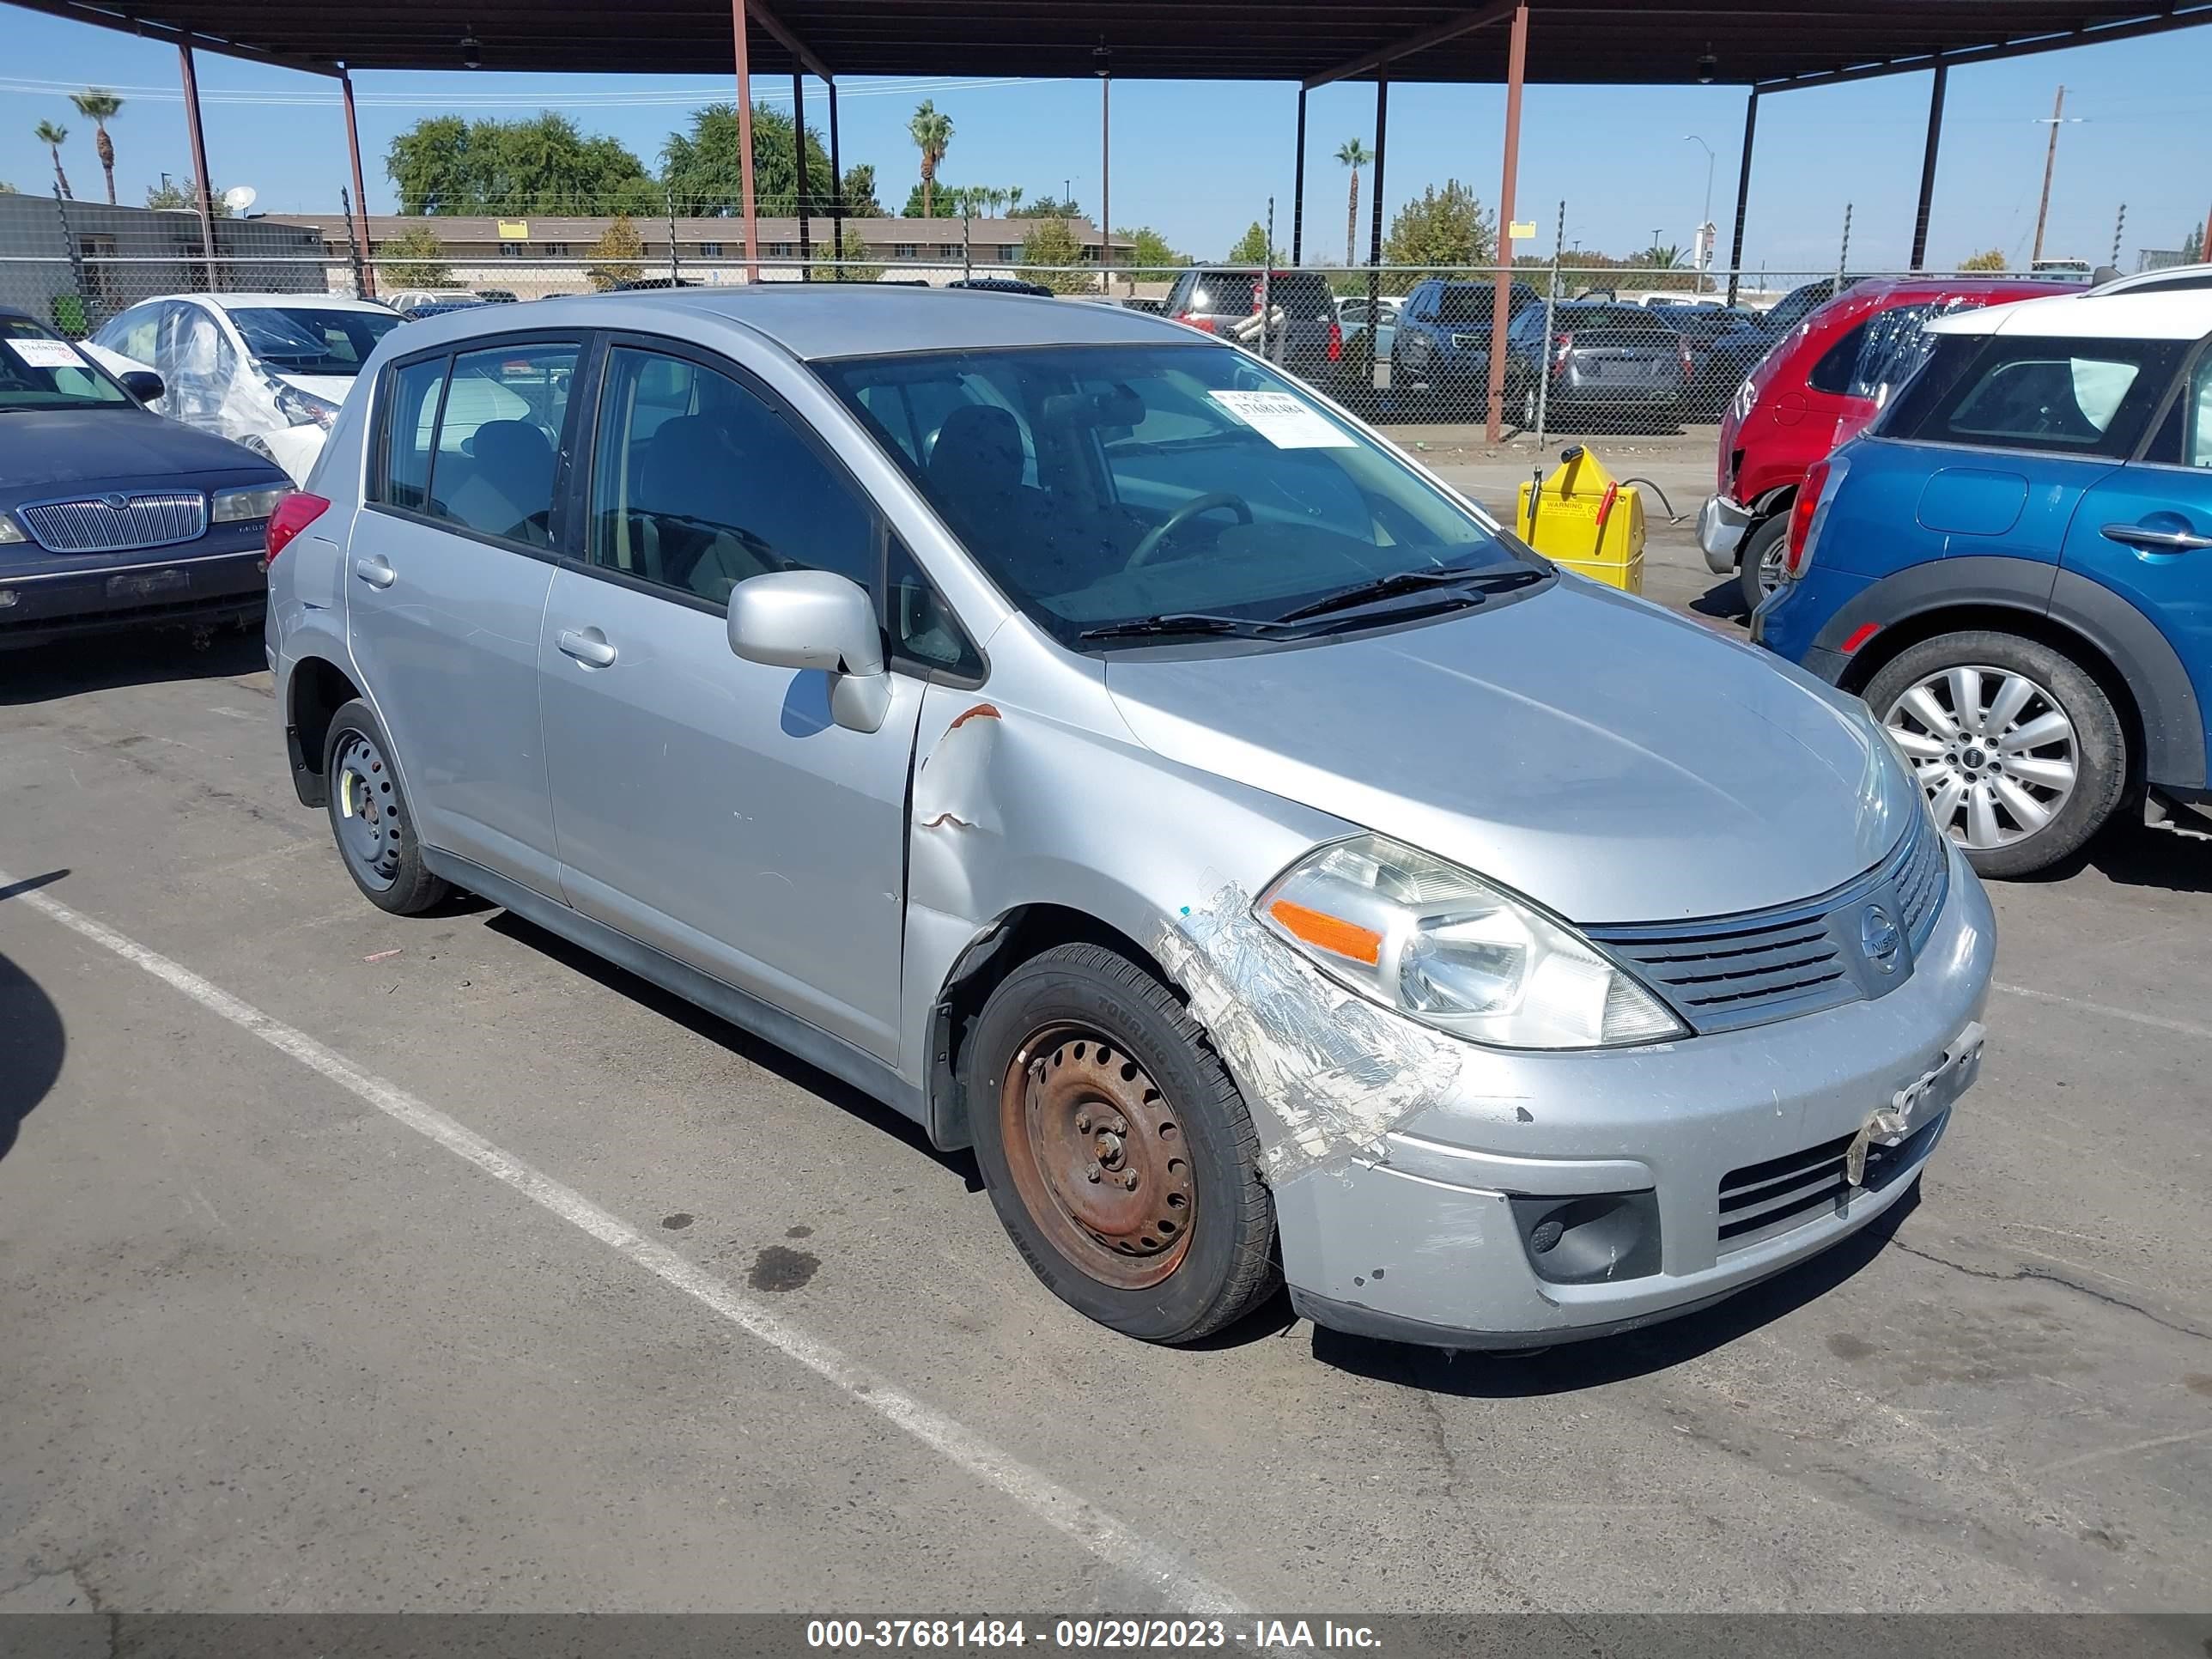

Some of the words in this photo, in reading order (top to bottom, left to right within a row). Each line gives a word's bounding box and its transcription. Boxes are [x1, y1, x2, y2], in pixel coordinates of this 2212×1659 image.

[1235, 404, 1306, 415] 37681484
[1871, 933, 1897, 954] NISS
[1098, 995, 1169, 1065] TOURING
